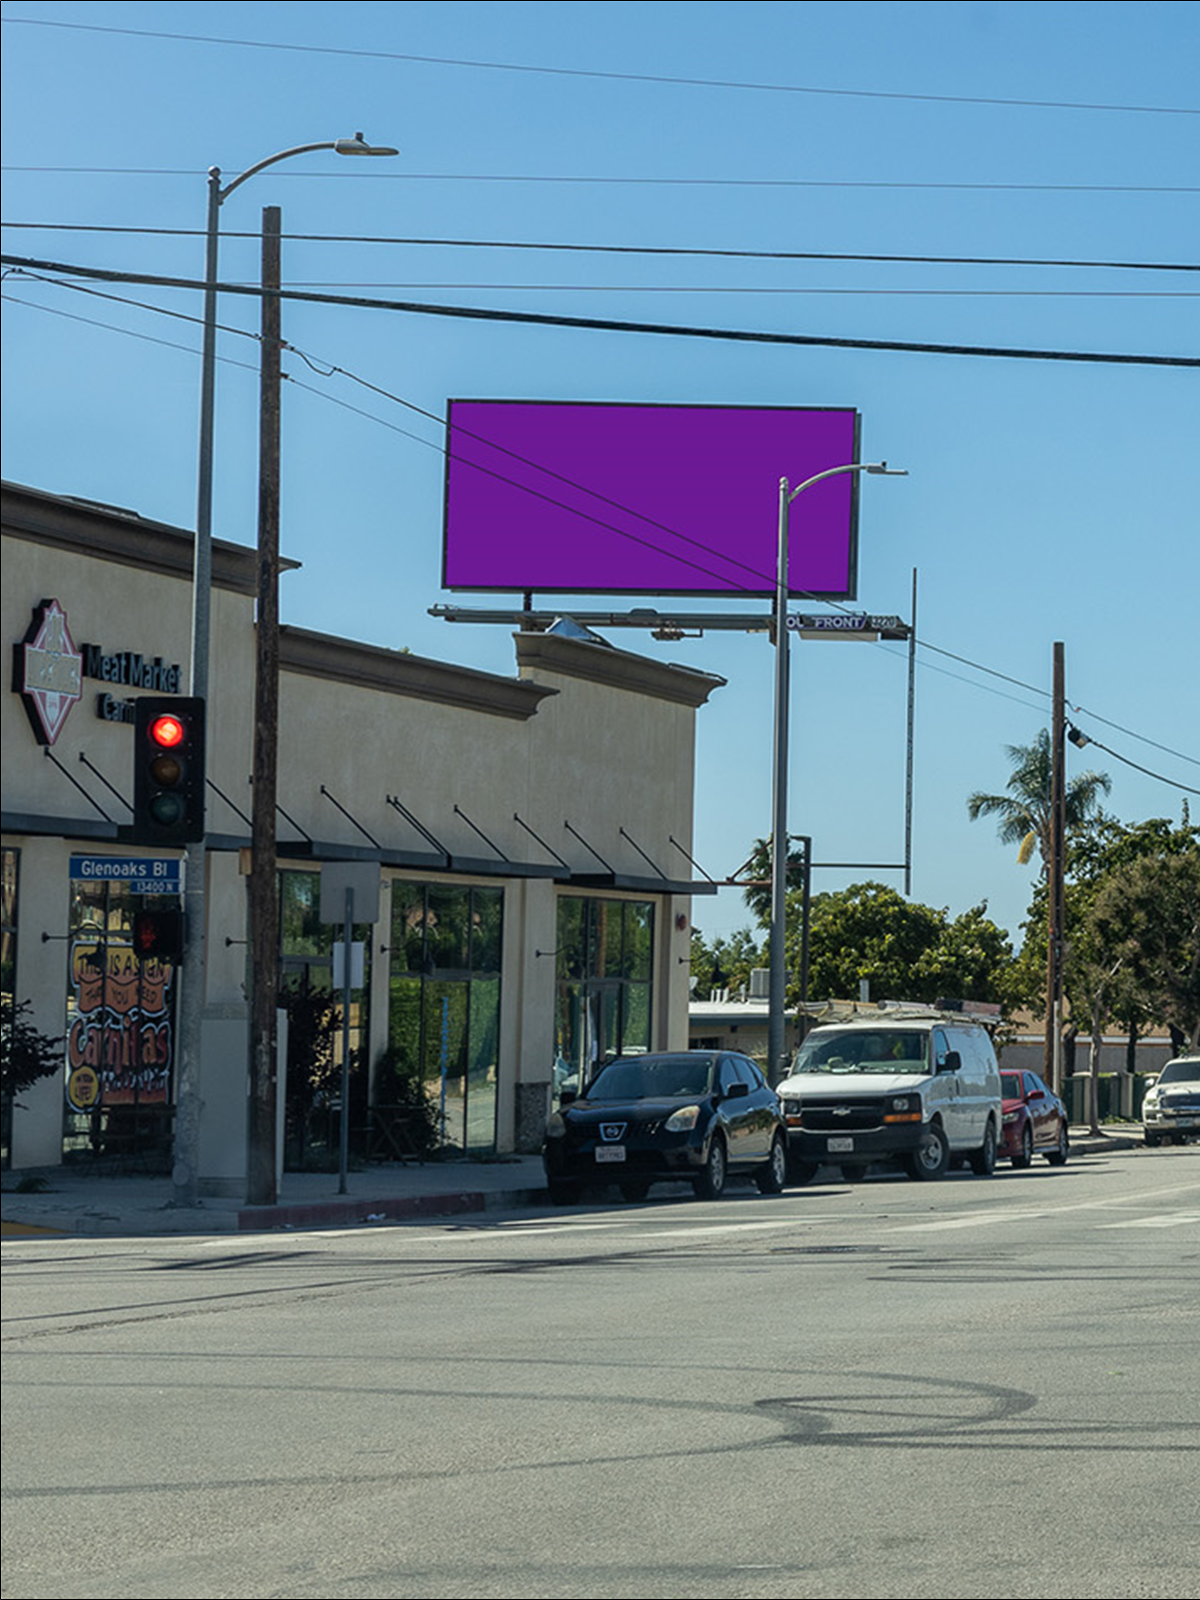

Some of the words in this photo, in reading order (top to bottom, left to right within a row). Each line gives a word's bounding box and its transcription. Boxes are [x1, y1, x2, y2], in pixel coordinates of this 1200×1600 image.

[82, 644, 127, 683] Meat
[128, 653, 182, 694] Market
[81, 860, 147, 877] Glenoaks
[153, 861, 168, 877] Bl
[123, 955, 133, 976] A
